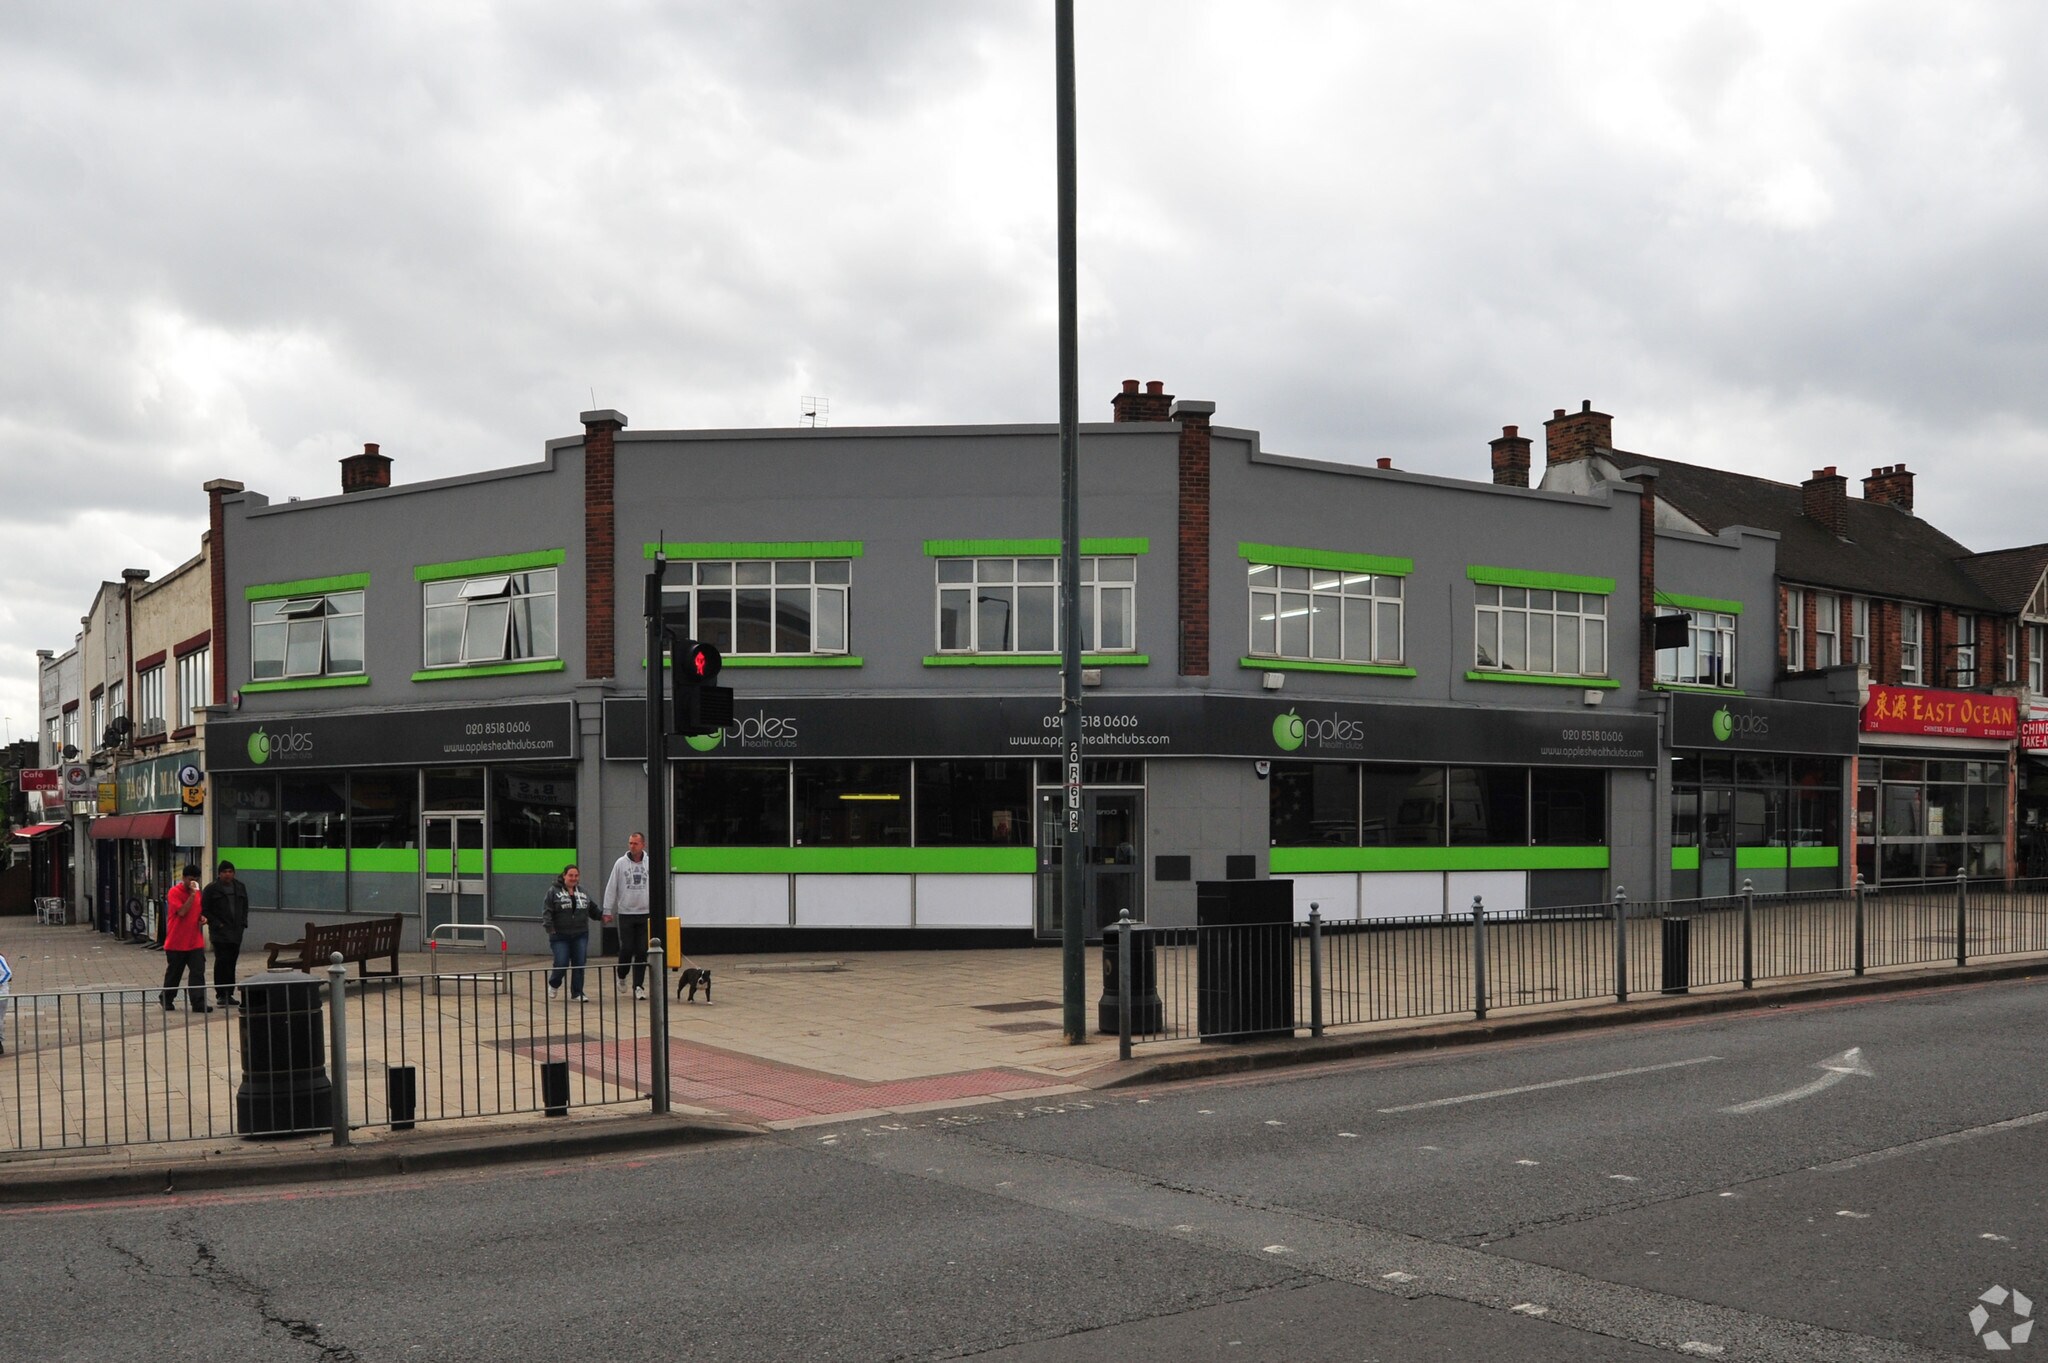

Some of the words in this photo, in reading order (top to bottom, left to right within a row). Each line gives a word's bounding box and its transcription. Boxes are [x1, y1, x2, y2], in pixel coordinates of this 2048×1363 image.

[1874, 690, 1908, 720] 東源
[1912, 695, 1956, 723] EAST
[1960, 699, 2013, 726] OCEAN
[465, 723, 483, 735] 020
[485, 722, 505, 734] 8518
[506, 721, 530, 733] 0606
[708, 709, 798, 747] pples
[1081, 715, 1101, 728] 518
[1103, 715, 1138, 728] 0606
[1723, 708, 1769, 739] apples
[1290, 711, 1364, 748] apples
[1562, 729, 1579, 740] 020
[1581, 730, 1600, 741] 8518
[1601, 730, 1623, 742] 0606
[259, 726, 313, 760] apples
[443, 738, 554, 754] www.appleshealthclubs.com
[745, 739, 772, 748] health
[774, 739, 798, 748] clubs
[1009, 733, 1170, 747] www.apphealthclubs.com
[2022, 735, 2048, 748] TAKE-A
[1540, 746, 1644, 758] www.appleshealthclubs.com
